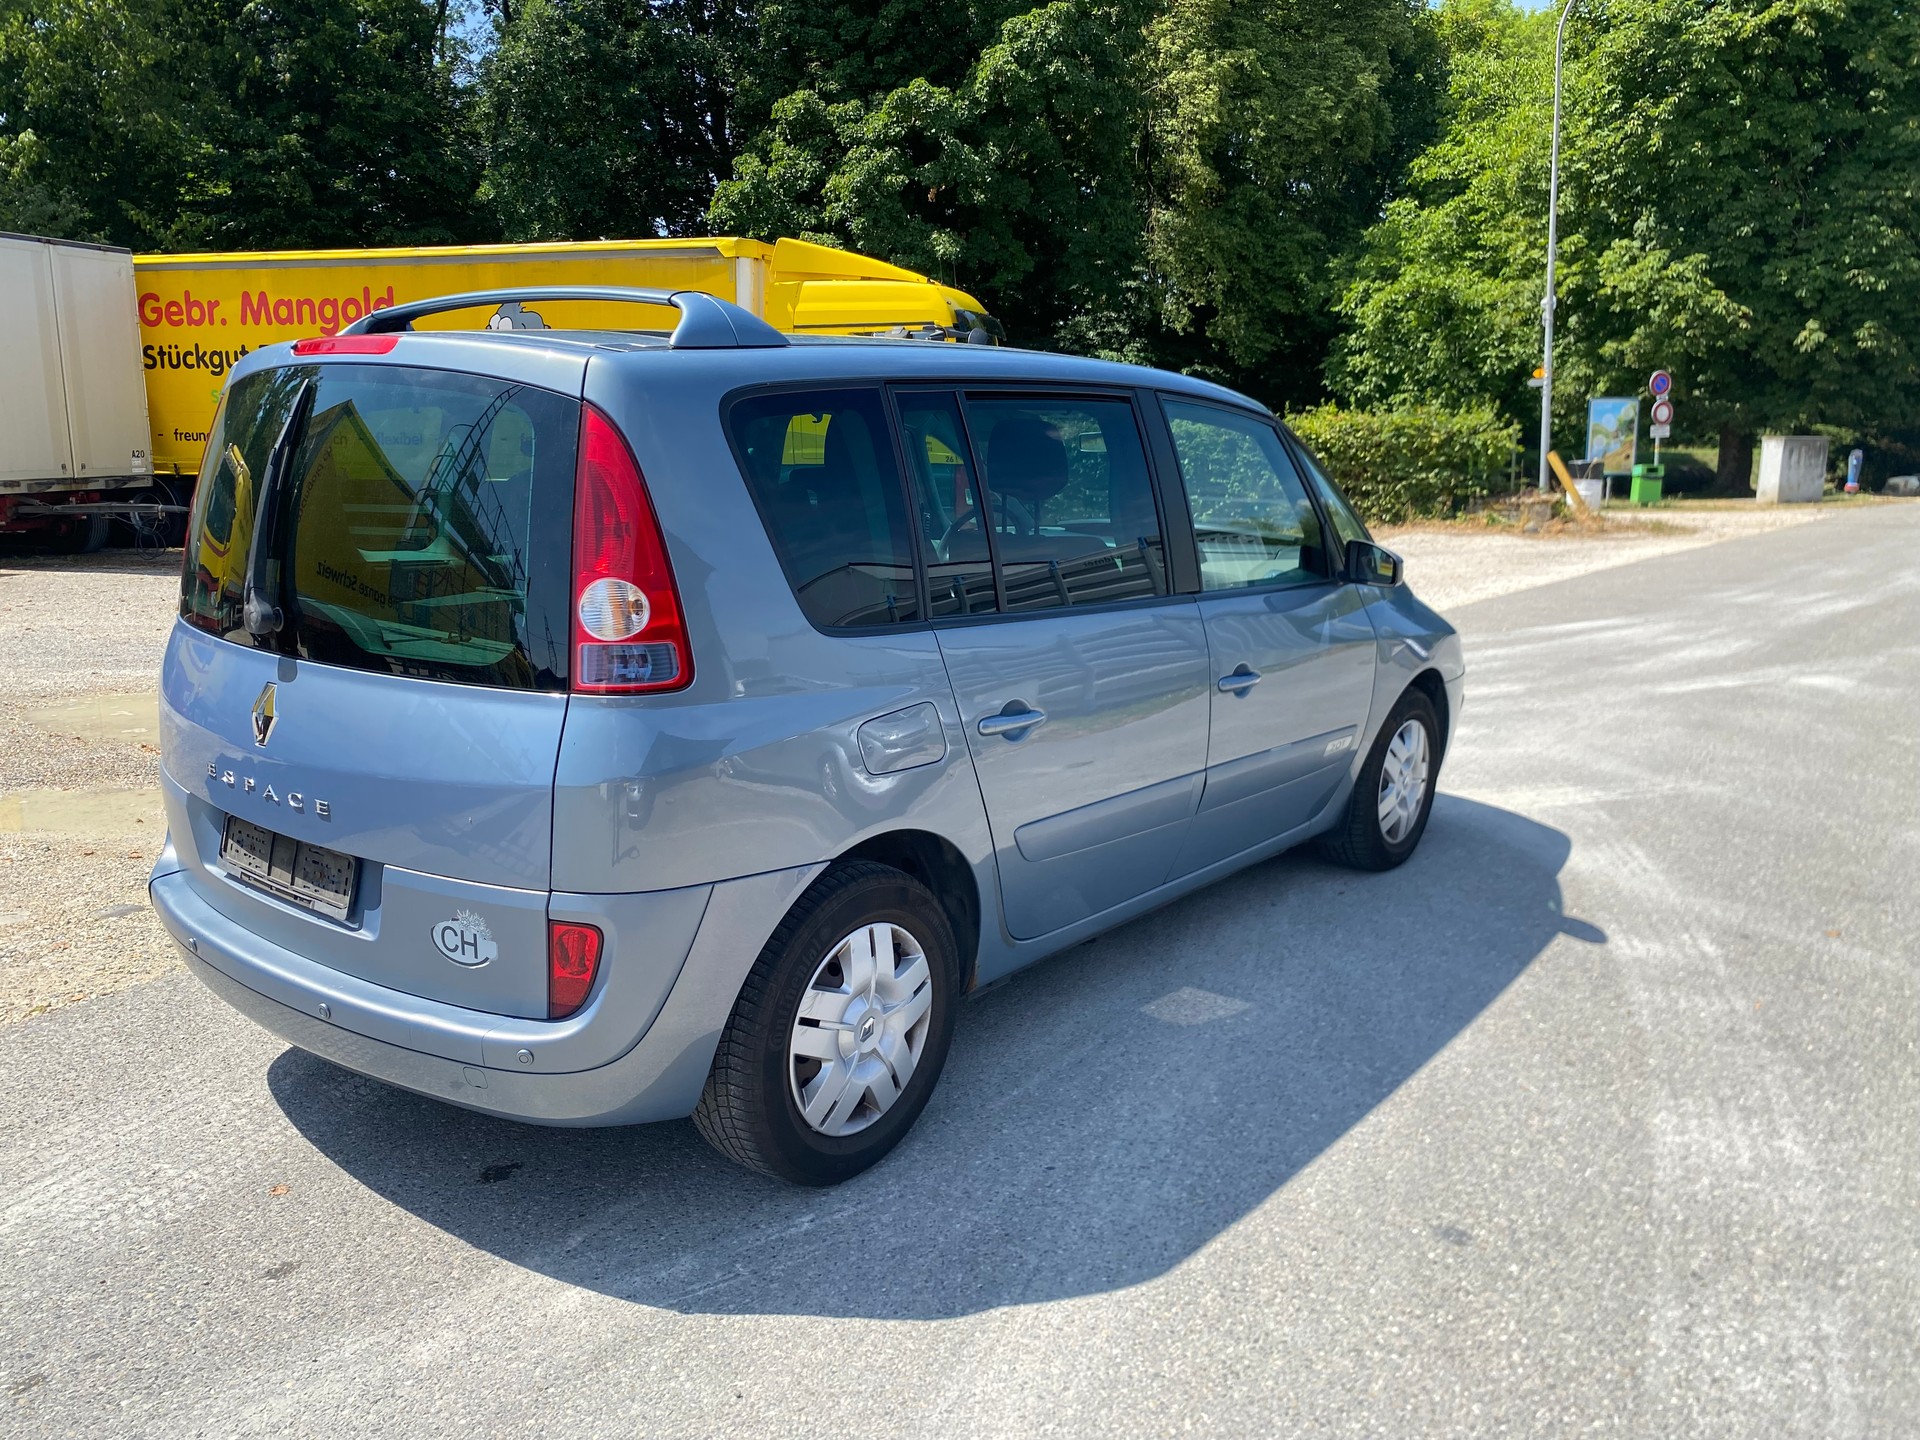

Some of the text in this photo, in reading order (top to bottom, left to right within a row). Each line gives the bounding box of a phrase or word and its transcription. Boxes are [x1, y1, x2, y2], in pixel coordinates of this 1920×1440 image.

[138, 286, 395, 336] Gebr. Mangold
[132, 450, 145, 458] A20
[206, 762, 331, 816] ESPACE
[441, 926, 478, 959] CH
